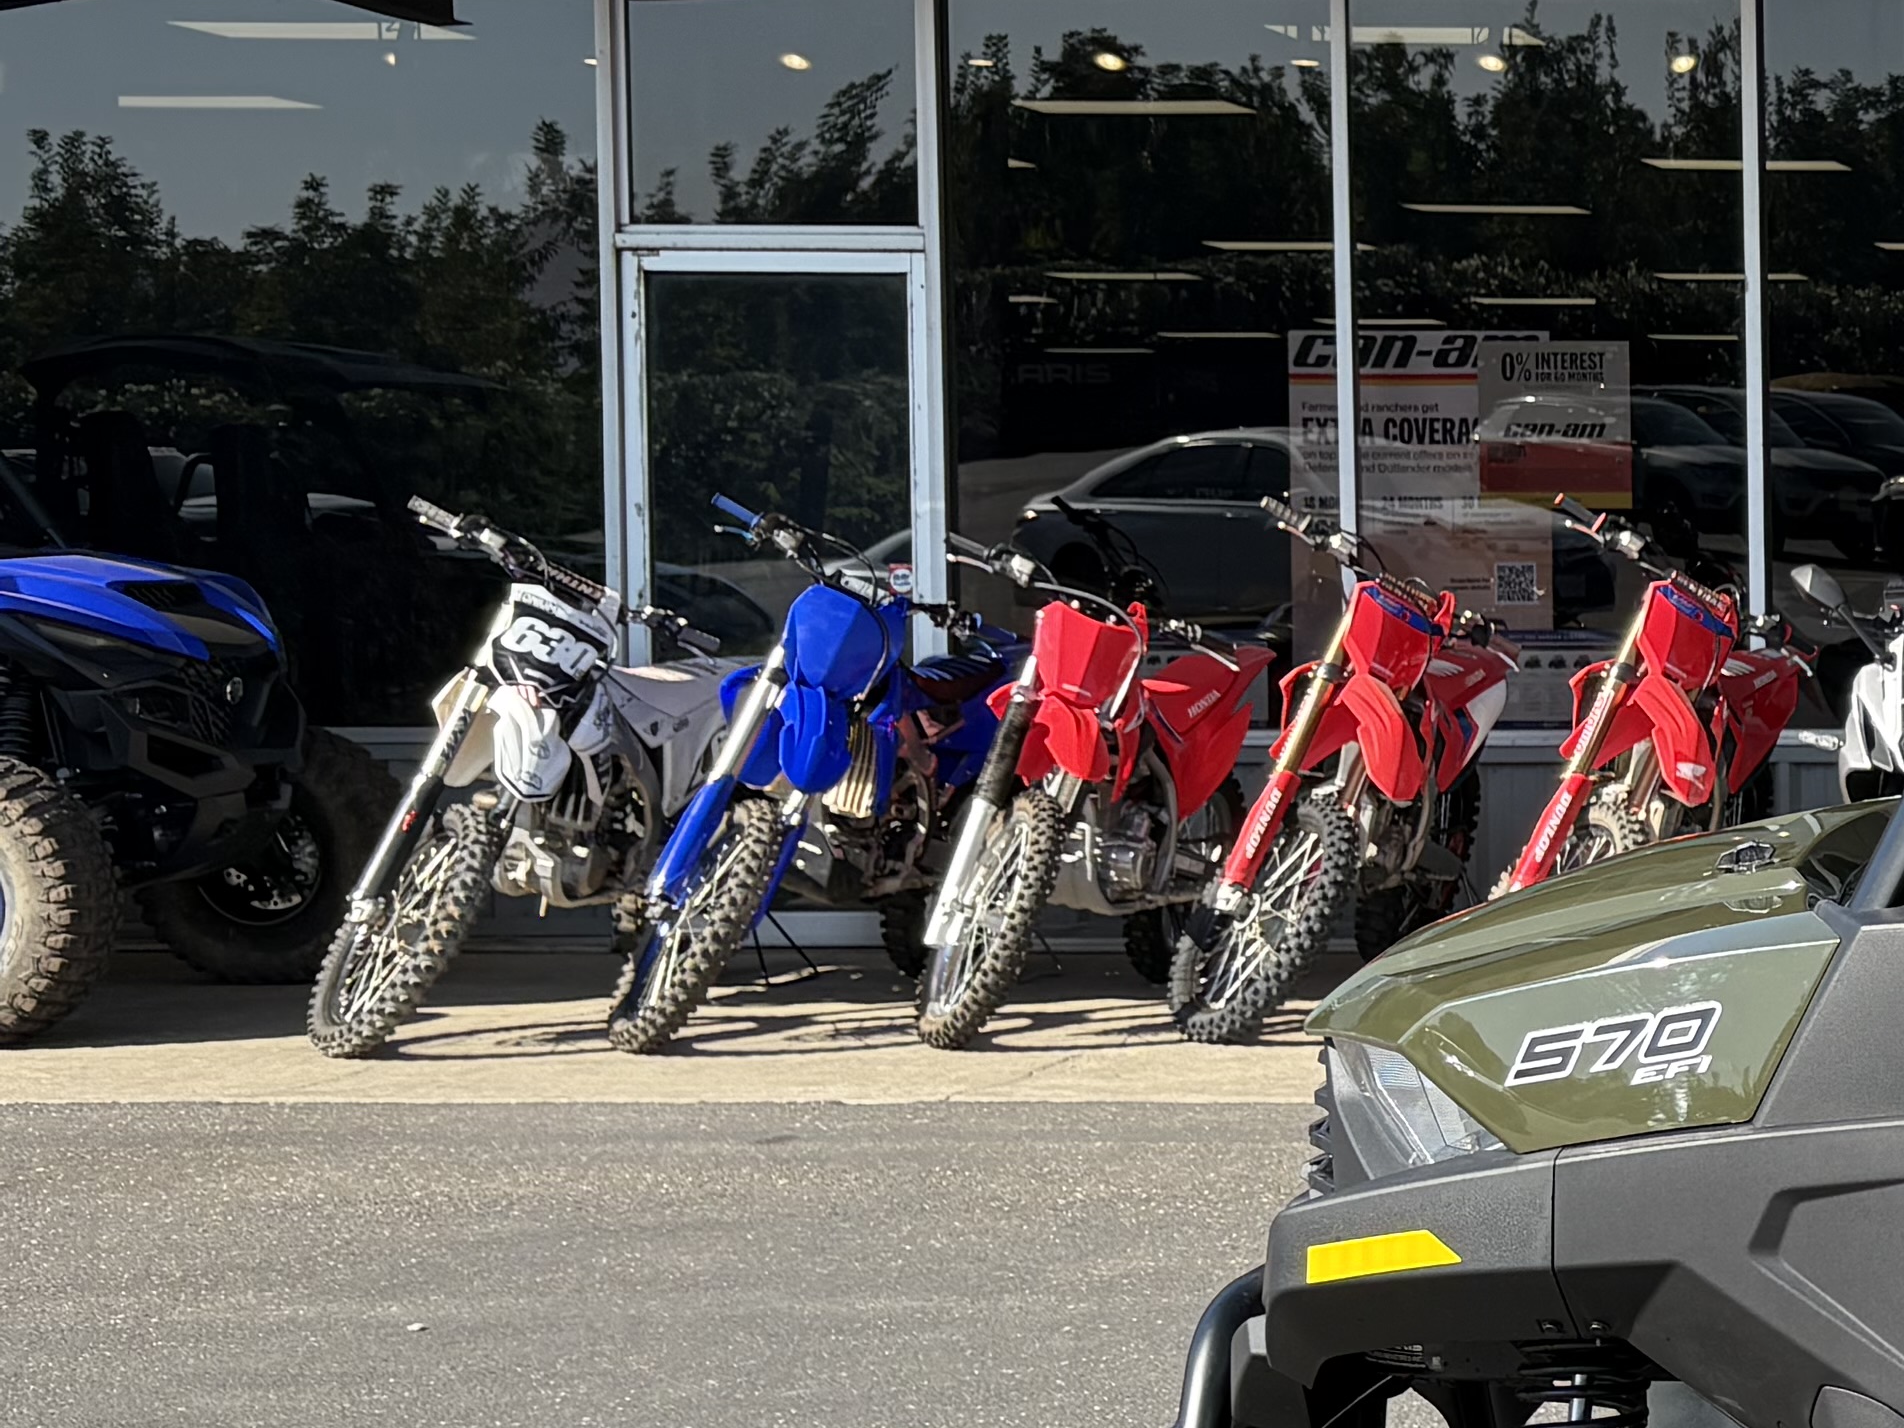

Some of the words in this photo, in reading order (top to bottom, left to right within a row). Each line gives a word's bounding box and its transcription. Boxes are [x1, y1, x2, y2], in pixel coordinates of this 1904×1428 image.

[1501, 353, 1531, 382] 0%
[1535, 352, 1605, 371] INTEREST
[1383, 417, 1479, 445] COVERA
[500, 616, 598, 681] 630
[1187, 689, 1222, 718] HONDA
[1245, 787, 1283, 860] DUNLOP
[1535, 791, 1573, 864] DUNLOP
[1504, 1000, 1722, 1087] 570
[1630, 1054, 1712, 1086] EFI
